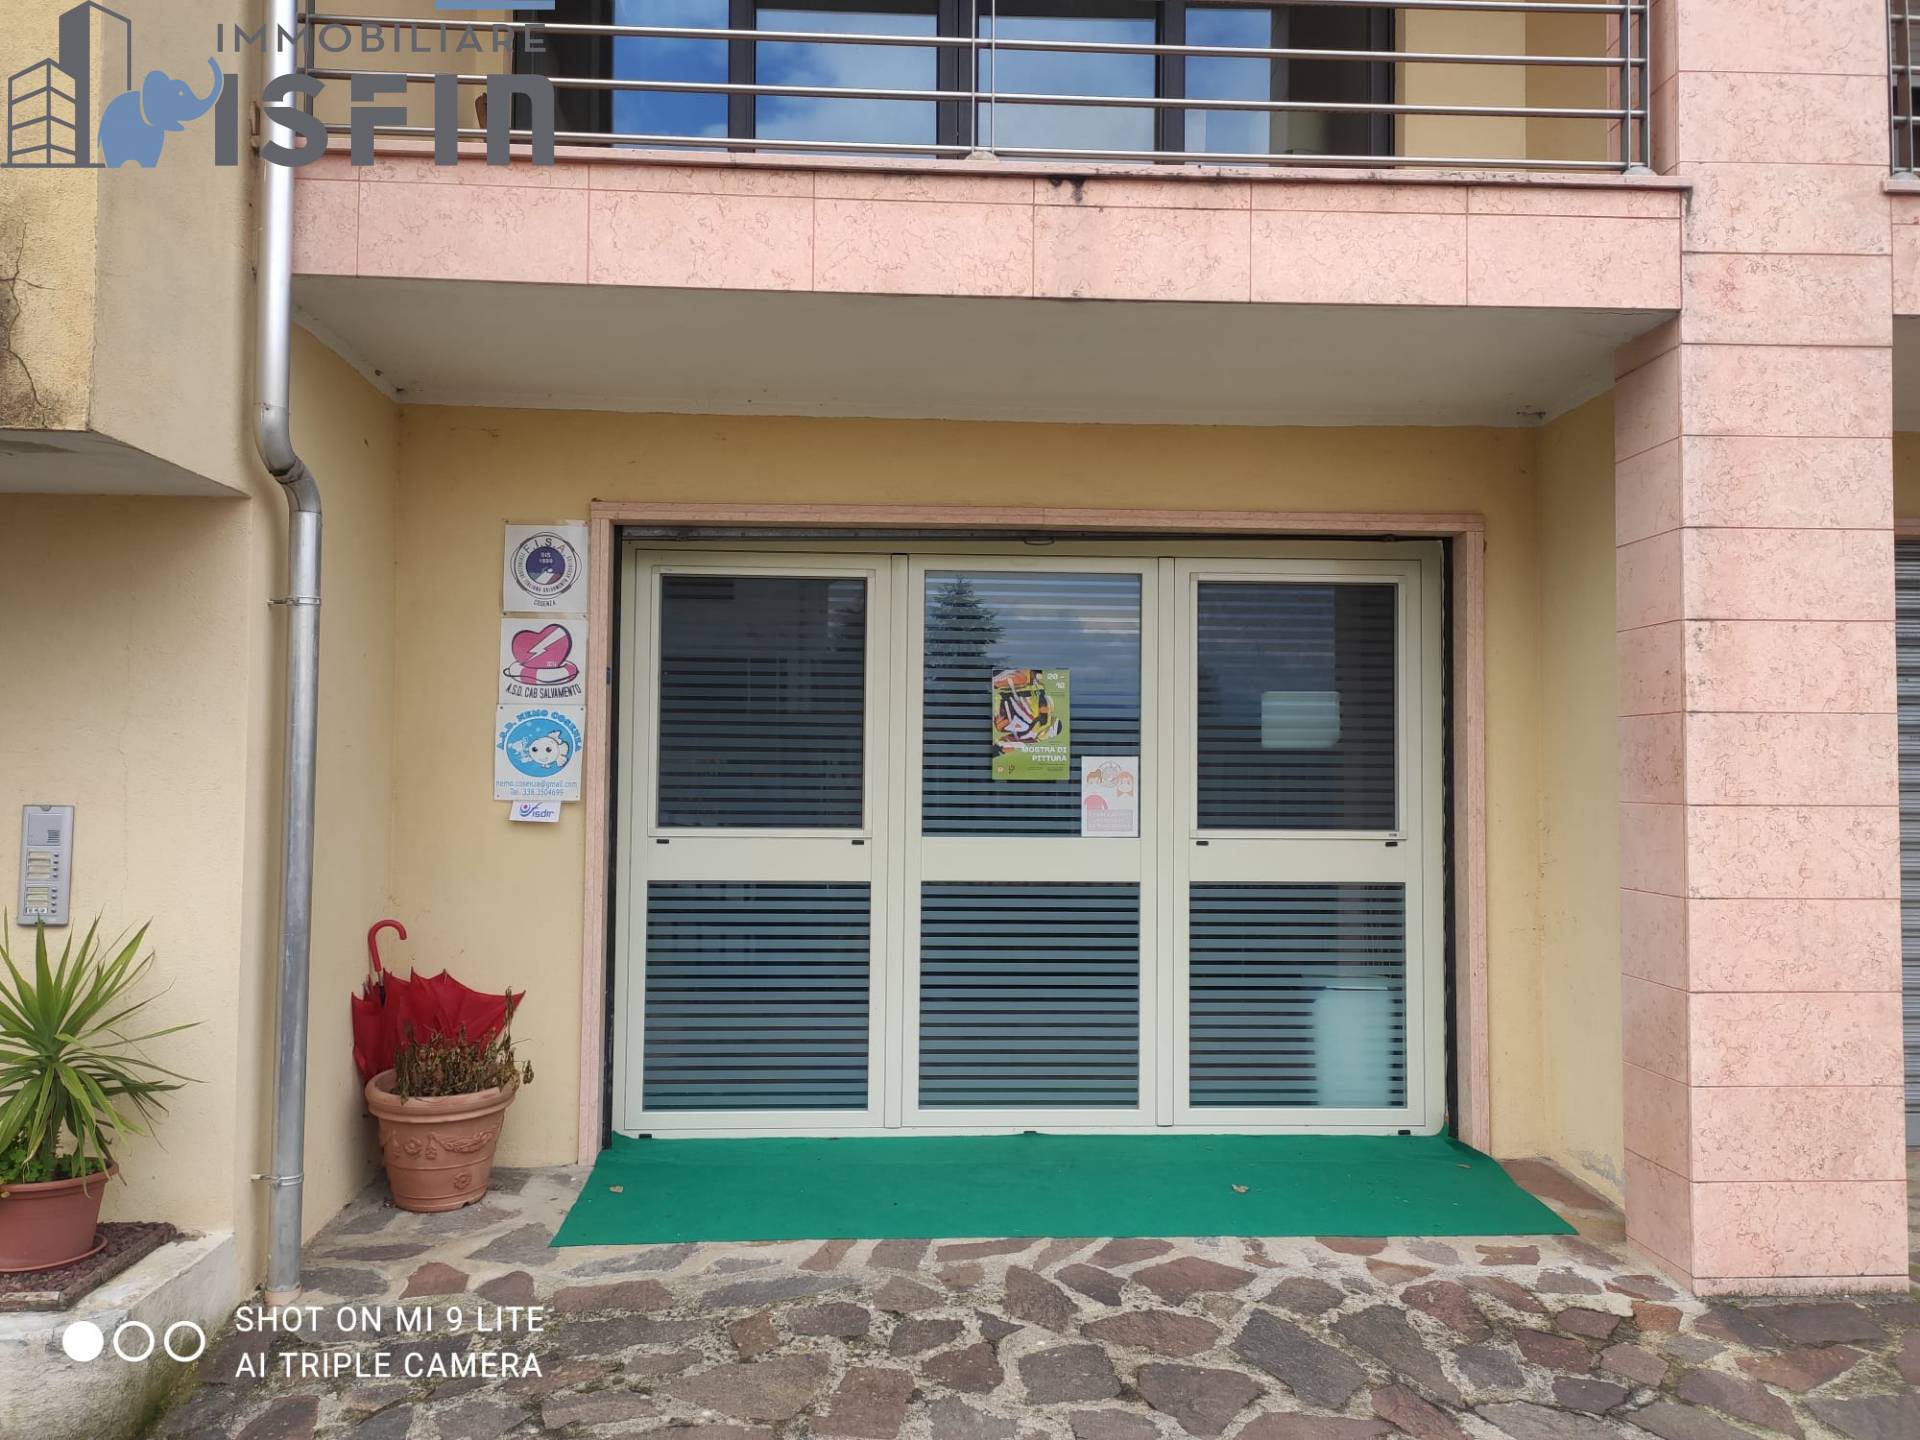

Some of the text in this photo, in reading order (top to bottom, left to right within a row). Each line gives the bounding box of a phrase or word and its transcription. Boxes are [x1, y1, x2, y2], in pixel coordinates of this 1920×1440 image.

[525, 687, 538, 698] CAB
[540, 683, 582, 698] SALVAMENTO
[516, 709, 548, 721] NEMO
[551, 711, 582, 752] COSENZA
[1032, 754, 1067, 762] PITTURA
